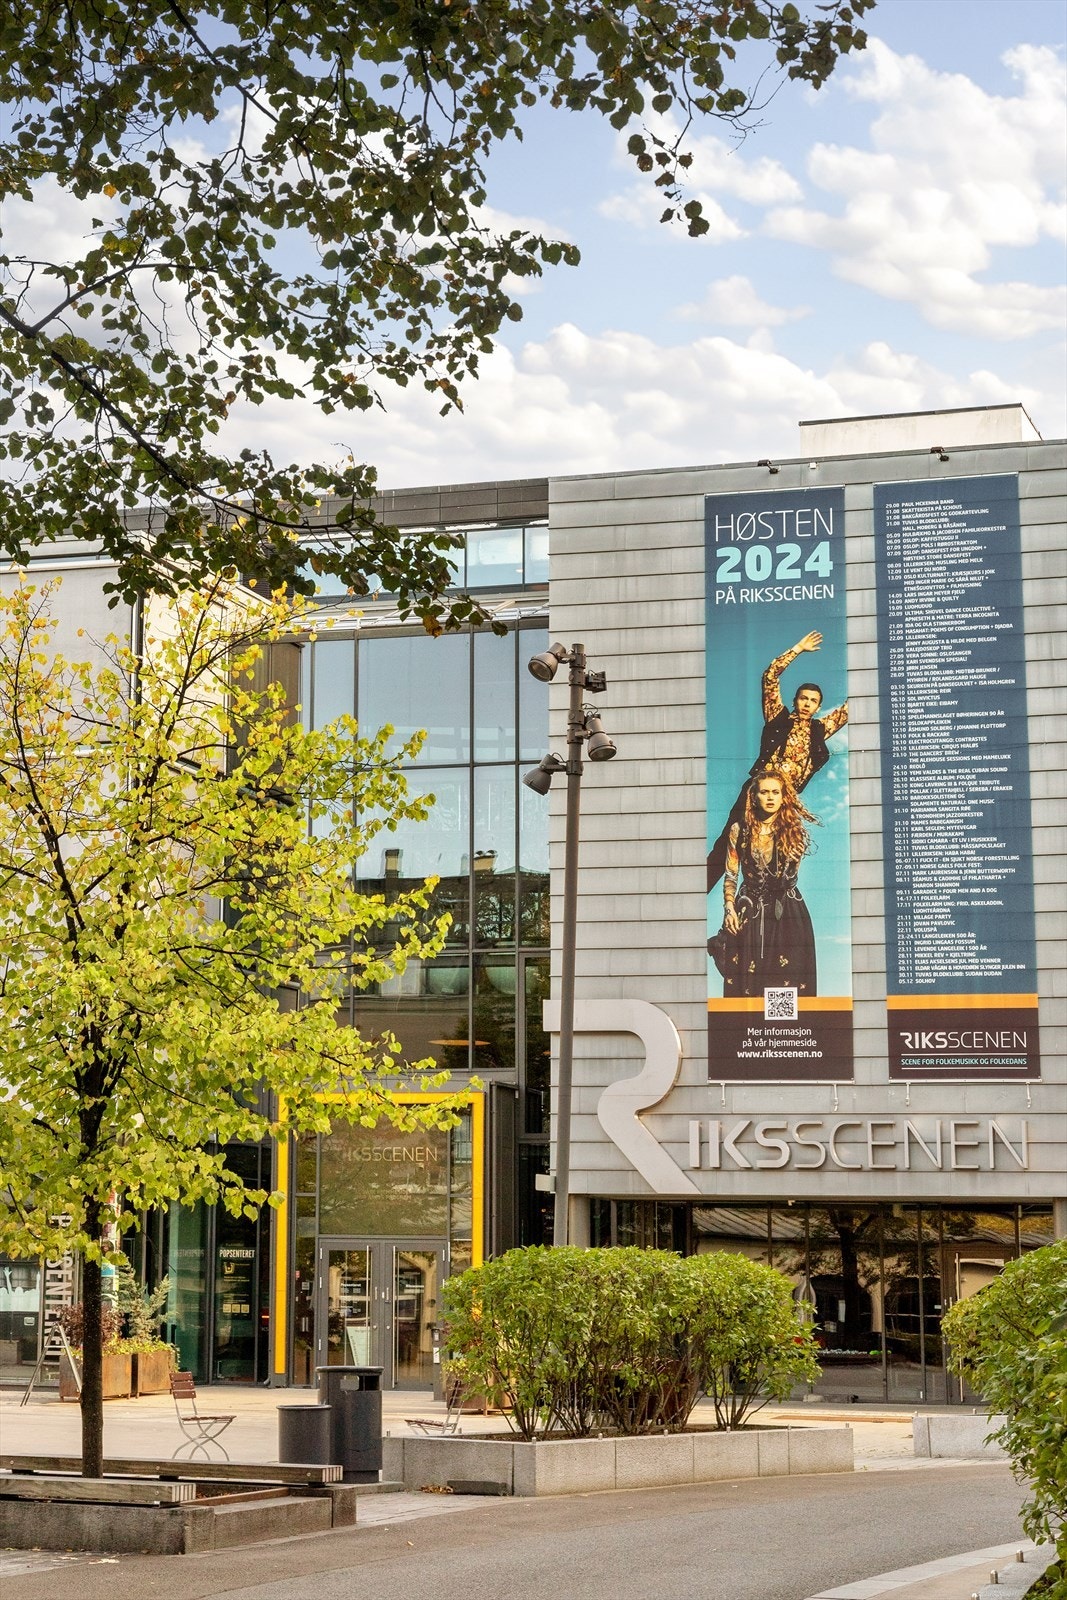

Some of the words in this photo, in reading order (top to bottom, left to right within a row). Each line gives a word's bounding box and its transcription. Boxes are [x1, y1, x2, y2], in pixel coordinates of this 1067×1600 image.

[716, 508, 833, 542] HØSTEN
[716, 541, 834, 584] 2024
[716, 586, 736, 604] PÅ
[740, 584, 834, 604] RIKSSCENEN
[747, 1027, 762, 1036] Mer
[764, 1026, 812, 1038] informasjon
[900, 1031, 1027, 1048] RIKSSCENEN
[742, 1038, 752, 1048] på
[754, 1038, 767, 1047] vår
[768, 1038, 817, 1048] hjemmeside
[736, 1050, 823, 1058] www.riksscenen.no
[542, 999, 1029, 1194] RIKSSCENEN
[220, 1250, 255, 1258] POPSENTERET
